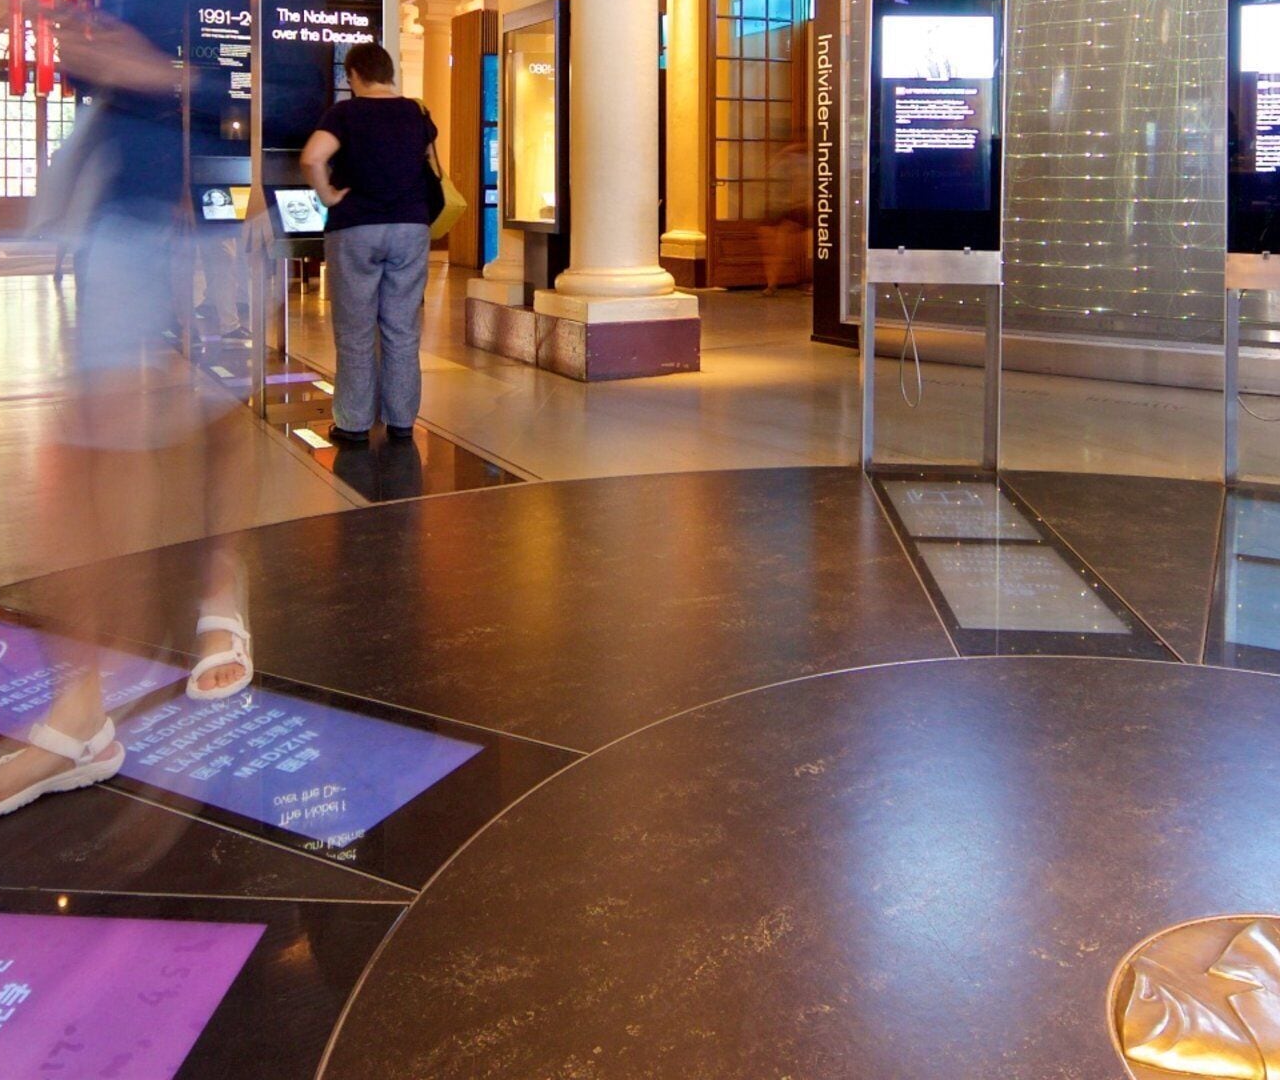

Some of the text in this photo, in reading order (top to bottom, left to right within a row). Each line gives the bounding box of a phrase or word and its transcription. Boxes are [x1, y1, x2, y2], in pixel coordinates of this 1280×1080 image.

[271, 27, 374, 44] over the Decades
[276, 7, 369, 27] The Nobel Prize
[818, 33, 834, 261] Individer–Individuals
[164, 708, 287, 774] LÄÄKETIEDE
[232, 729, 320, 779] MEDIZIN
